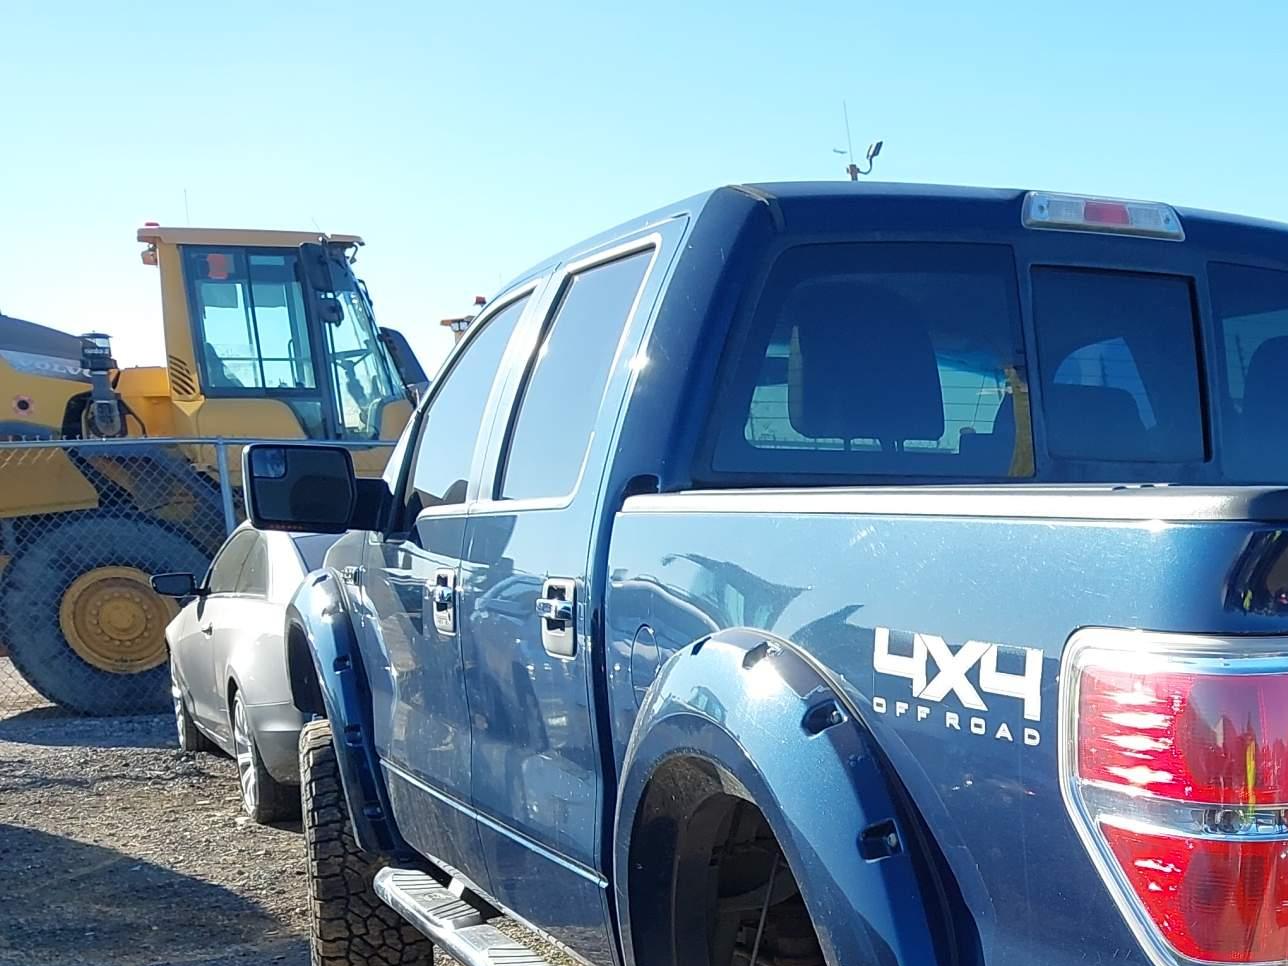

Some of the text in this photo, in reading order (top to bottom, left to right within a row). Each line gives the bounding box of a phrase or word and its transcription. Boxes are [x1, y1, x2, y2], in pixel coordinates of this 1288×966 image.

[873, 626, 1044, 722] 4X4
[872, 696, 1041, 746] OFF ROAD
